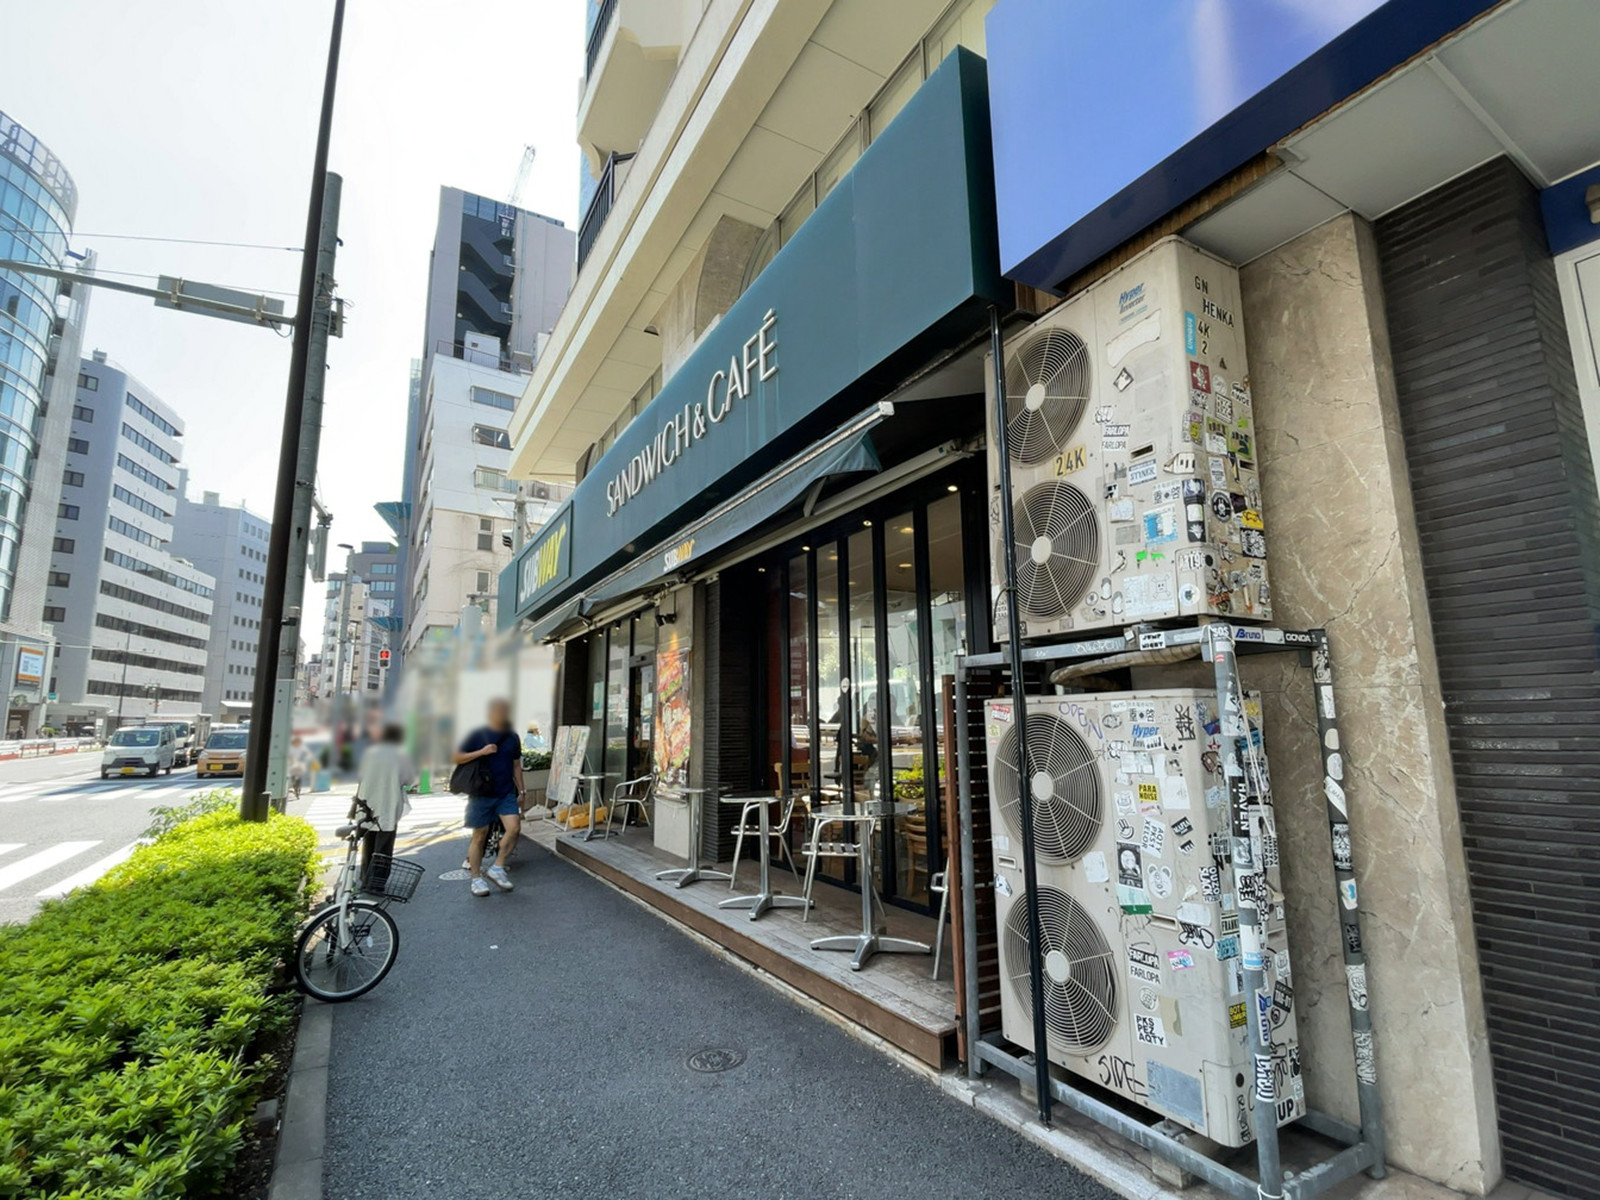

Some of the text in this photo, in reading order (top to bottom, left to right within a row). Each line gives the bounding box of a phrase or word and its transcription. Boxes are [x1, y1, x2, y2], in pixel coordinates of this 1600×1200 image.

[1203, 299, 1234, 328] HENKA
[1198, 321, 1210, 339] 4K
[1202, 341, 1208, 355] 2
[707, 308, 779, 424] CAFÉ
[1056, 447, 1085, 476] 24K
[520, 521, 567, 603] SUBWAY
[664, 539, 695, 572] SUBWAY
[1132, 724, 1160, 739] Hyper
[1138, 784, 1157, 792] PARA
[1139, 792, 1158, 801] NOISE
[1237, 783, 1250, 831] HAVEN
[1199, 867, 1212, 896] SLACK
[1209, 866, 1220, 895] OUZO
[1130, 965, 1160, 984] FARLOPA
[1135, 1015, 1154, 1027] PKS
[1137, 1024, 1155, 1036] PEZ
[1139, 1032, 1164, 1046] AQTY
